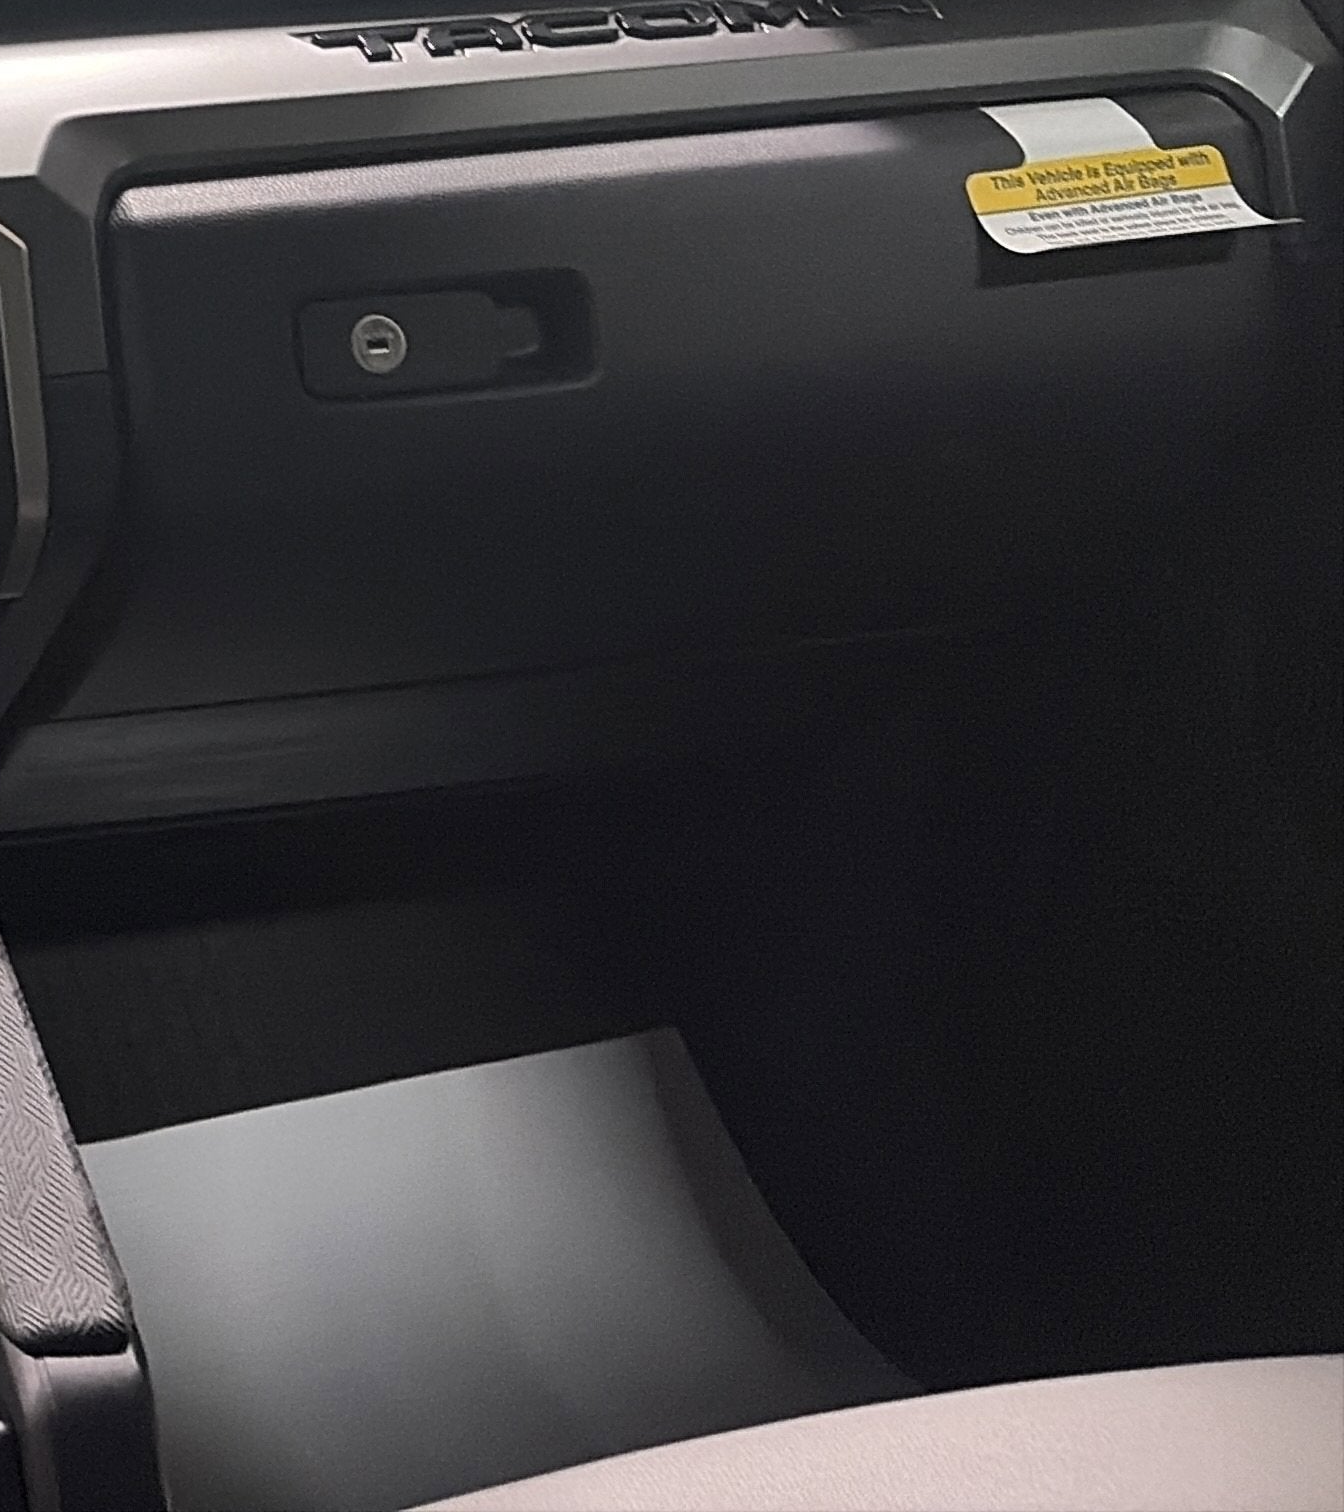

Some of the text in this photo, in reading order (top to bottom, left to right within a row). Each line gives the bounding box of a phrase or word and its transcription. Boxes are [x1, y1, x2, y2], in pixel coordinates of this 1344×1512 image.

[989, 174, 1026, 191] This
[1026, 166, 1083, 186] Vehicle
[1102, 155, 1175, 178] Equipped
[1176, 151, 1211, 167] with
[1035, 173, 1178, 203] Advanced Air Bags
[1028, 192, 1203, 222] Even with Advanced Air Bags
